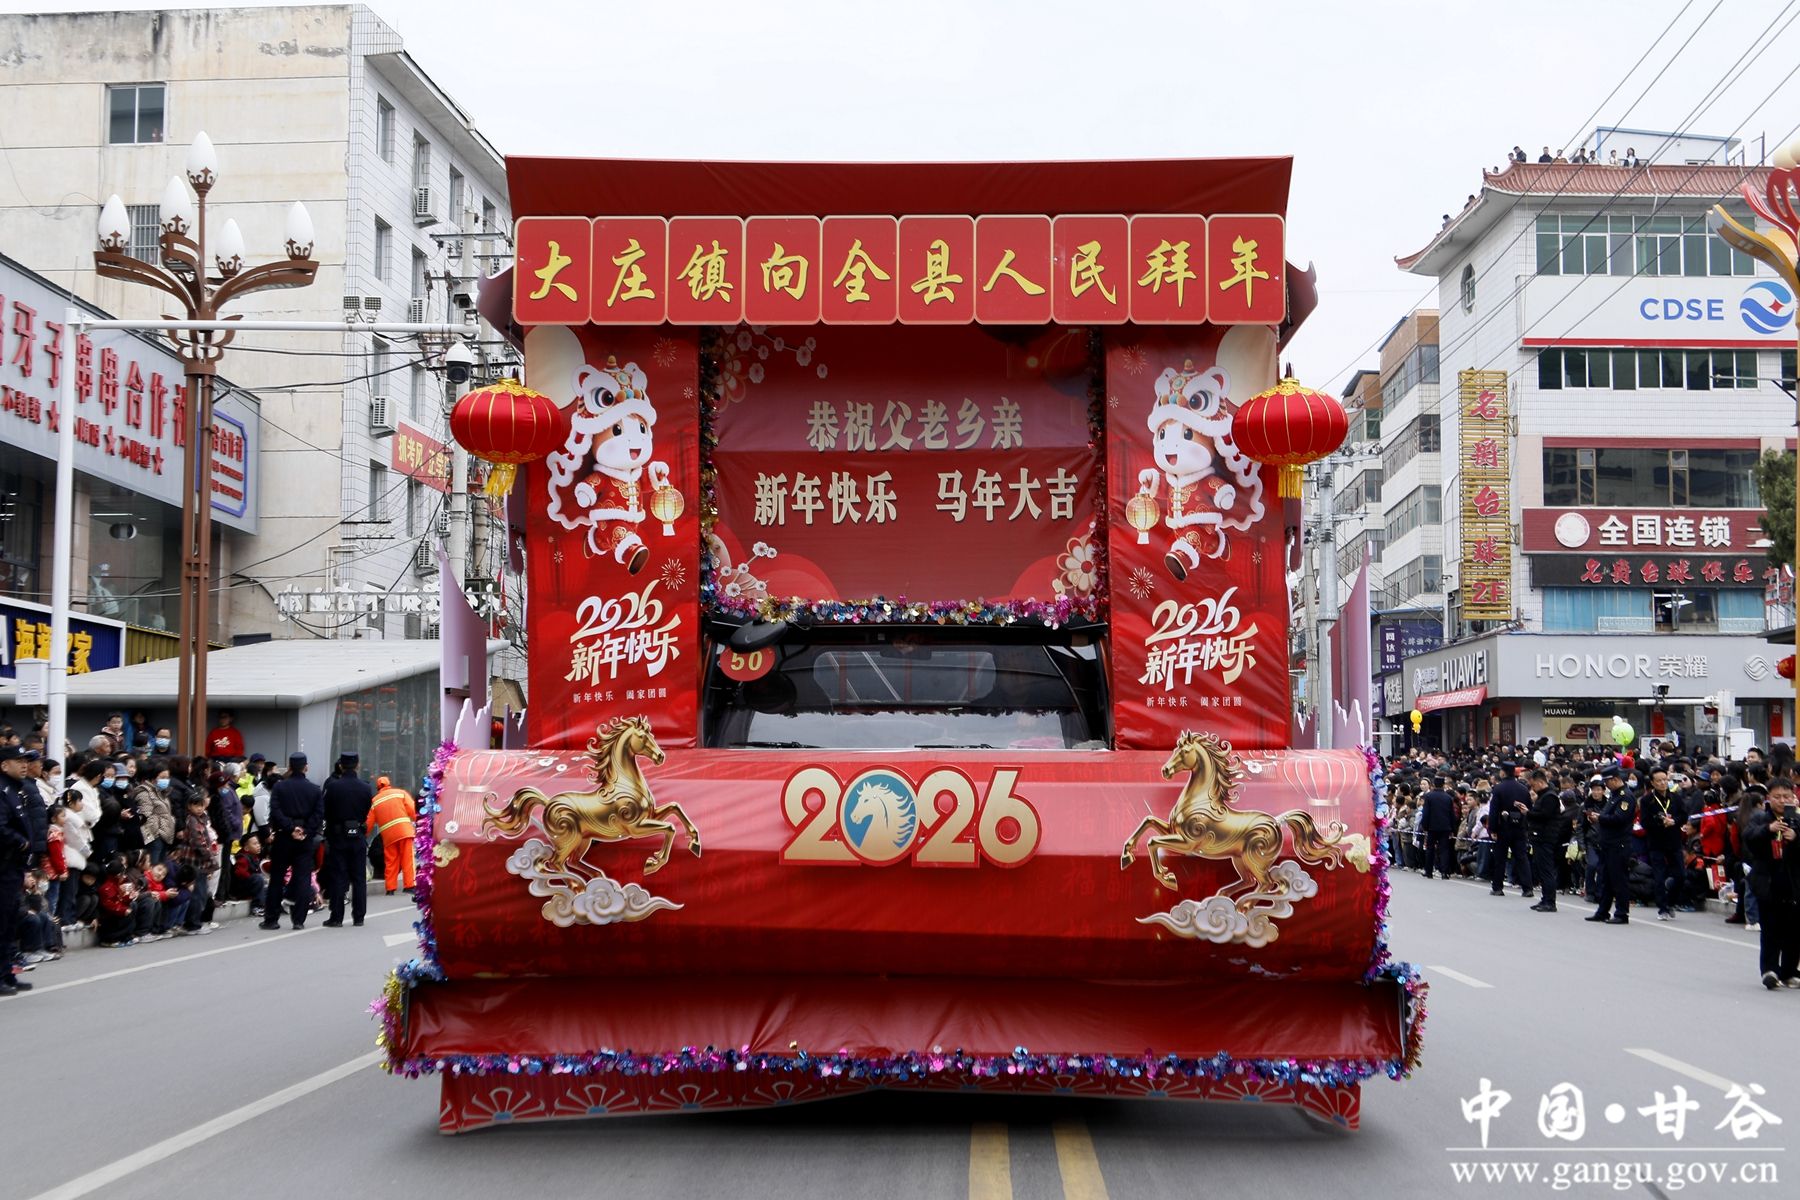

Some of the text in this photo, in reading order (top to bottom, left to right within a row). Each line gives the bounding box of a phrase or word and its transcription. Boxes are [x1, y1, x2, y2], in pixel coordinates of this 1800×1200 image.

[530, 236, 1269, 308] 大庄镇向全县人民拜年
[1640, 298, 1724, 321] CDSE
[0, 294, 187, 447] 牙子串串合作社
[806, 397, 1023, 452] 恭祝父老乡亲
[753, 467, 1078, 525] 新年快乐 马年大吉
[1471, 389, 1505, 603] 名爵台球 2F
[1598, 514, 1732, 548] 全国连锁
[570, 579, 663, 644] 2026
[1145, 586, 1240, 647] 2026
[564, 613, 681, 687] 新年快乐
[730, 650, 763, 671] 50
[1138, 622, 1258, 692] 新年快乐
[1441, 649, 1487, 692] HUAWEI
[1536, 654, 1708, 678] HONOR 荣耀
[573, 690, 614, 704] 新年快乐
[1146, 696, 1188, 707] 新年快乐
[1544, 708, 1576, 716] HUAWEI
[781, 764, 1040, 867] 2026
